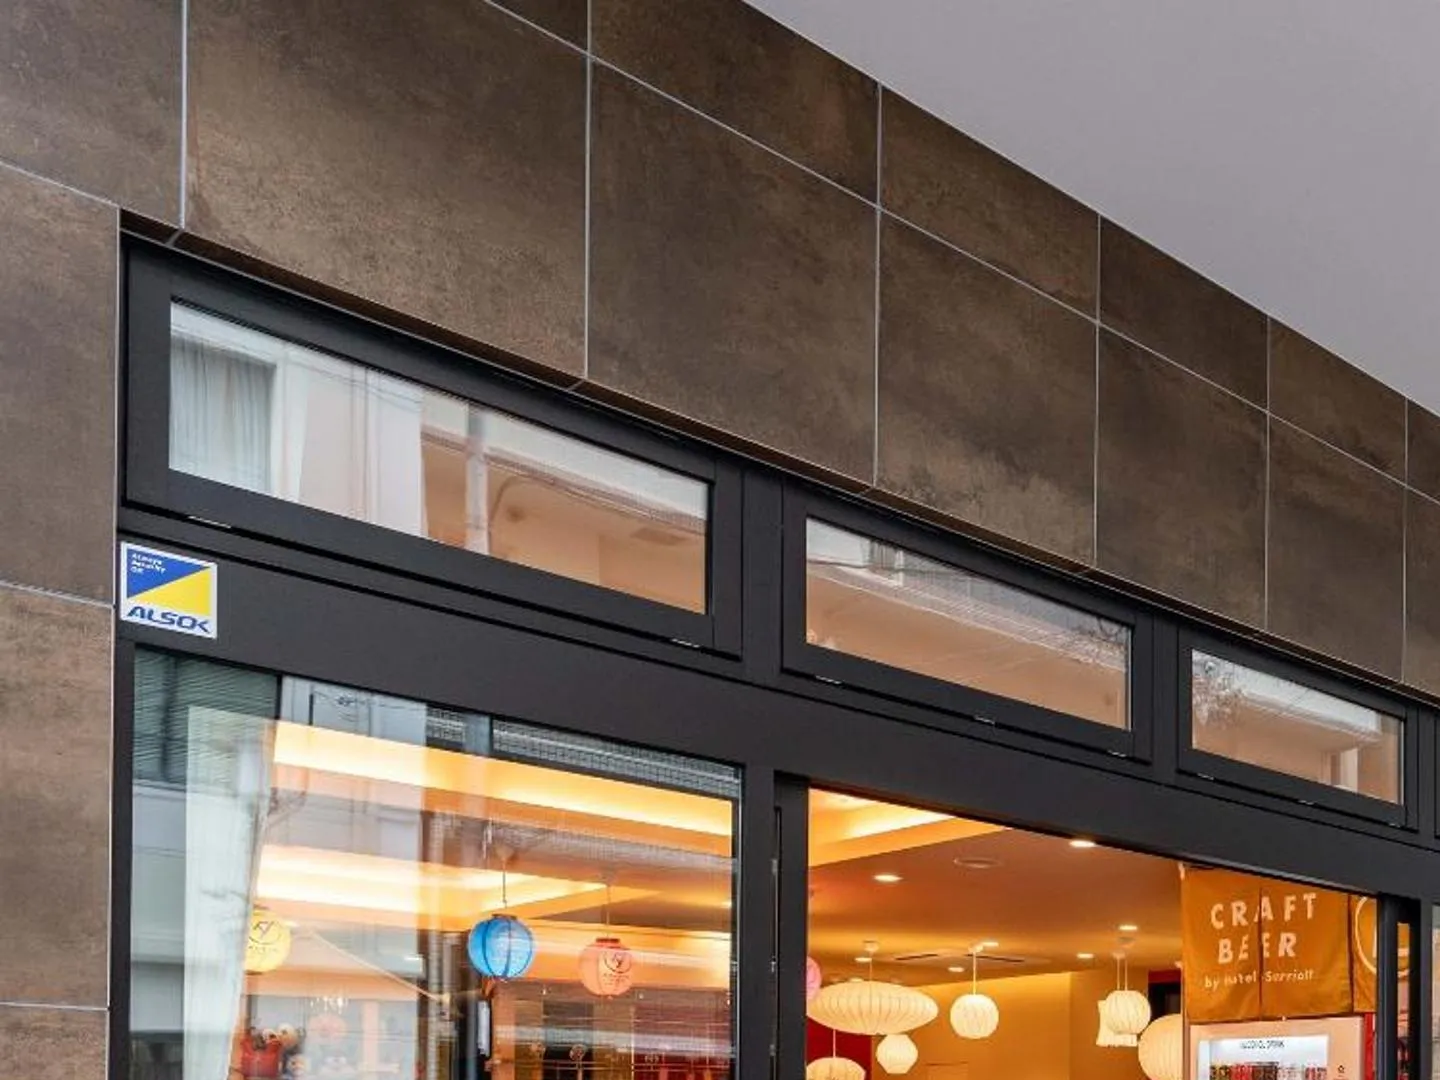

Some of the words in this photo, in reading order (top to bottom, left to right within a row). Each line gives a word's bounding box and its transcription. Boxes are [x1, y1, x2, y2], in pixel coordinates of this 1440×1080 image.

[127, 606, 211, 633] ALSOK
[1211, 893, 1316, 930] CRAFT
[1218, 932, 1297, 965] BEER
[1205, 975, 1220, 992] by
